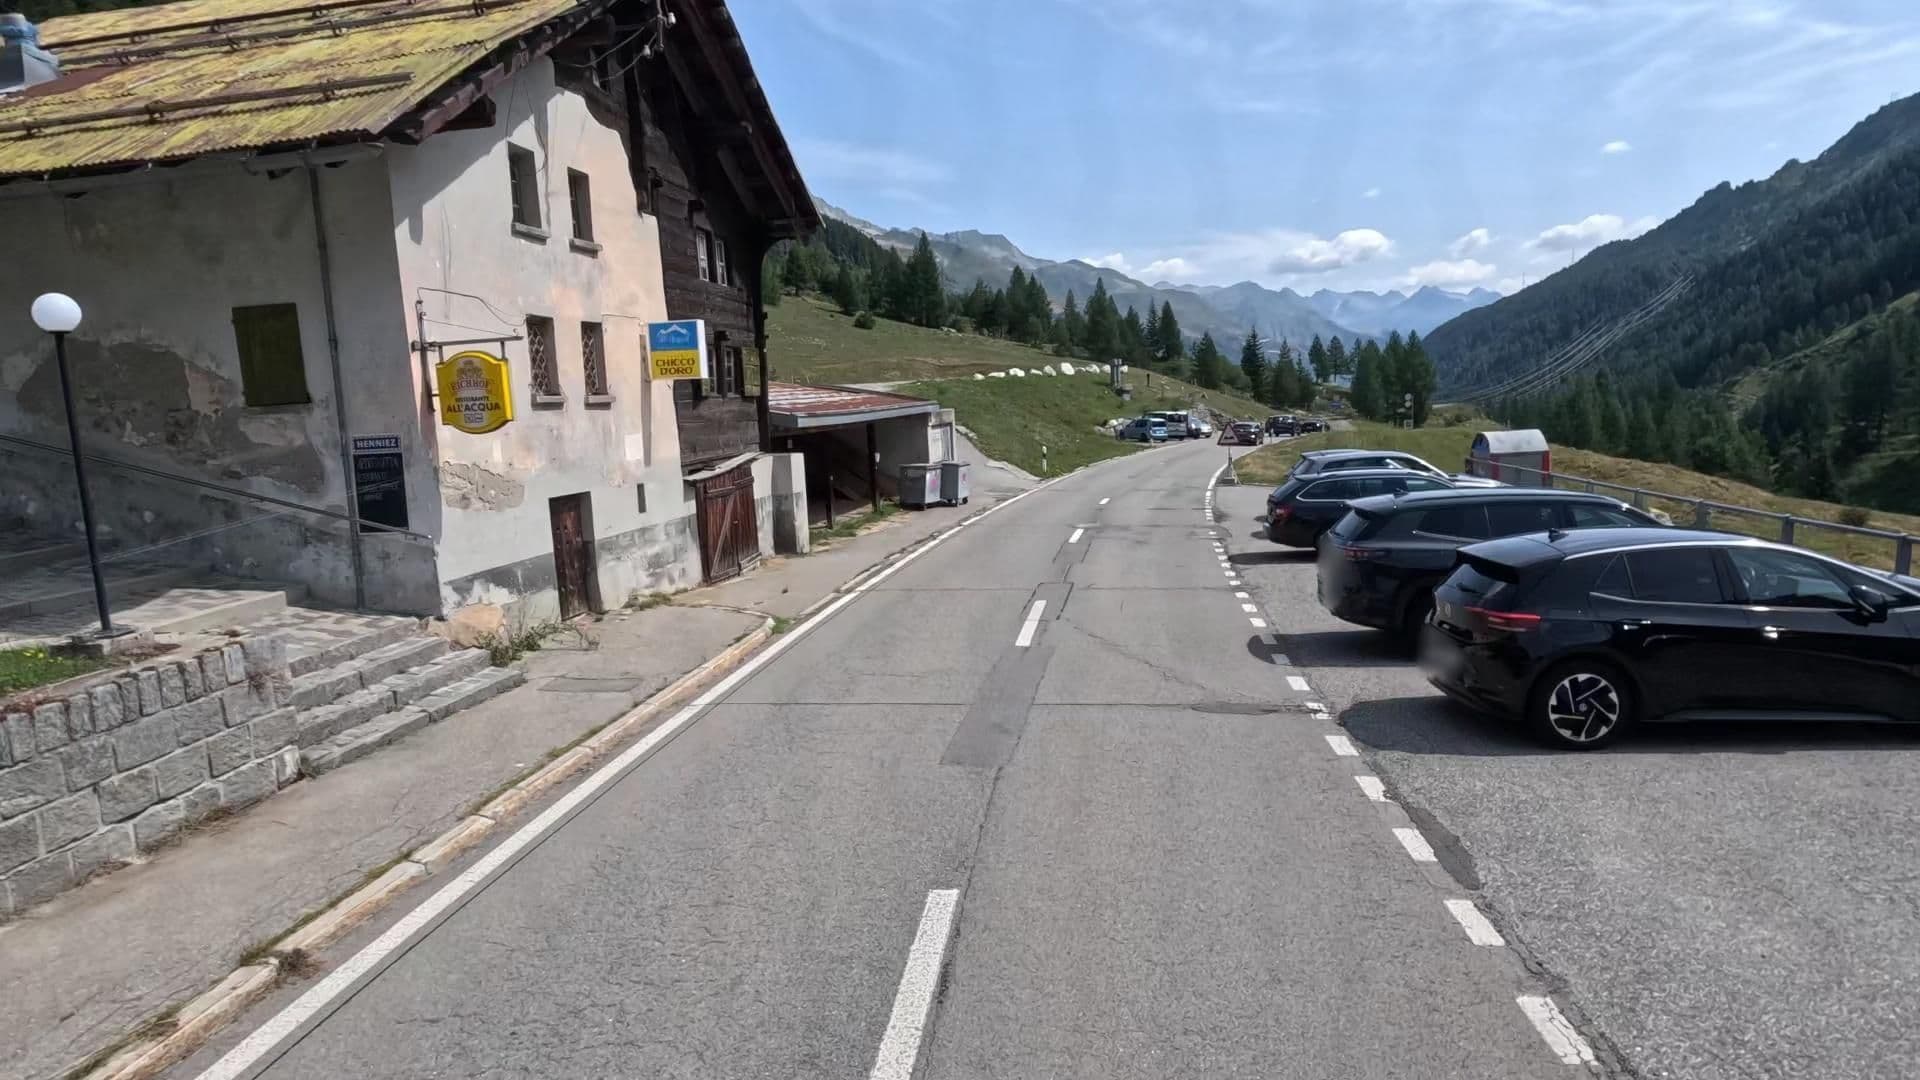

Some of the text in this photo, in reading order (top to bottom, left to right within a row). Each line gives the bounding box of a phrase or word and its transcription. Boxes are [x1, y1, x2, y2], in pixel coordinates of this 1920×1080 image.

[655, 358, 696, 367] CHICCO
[660, 366, 693, 376] D'ORO
[446, 402, 501, 414] ALL'ACQUA
[356, 438, 397, 449] HENNIEZ
